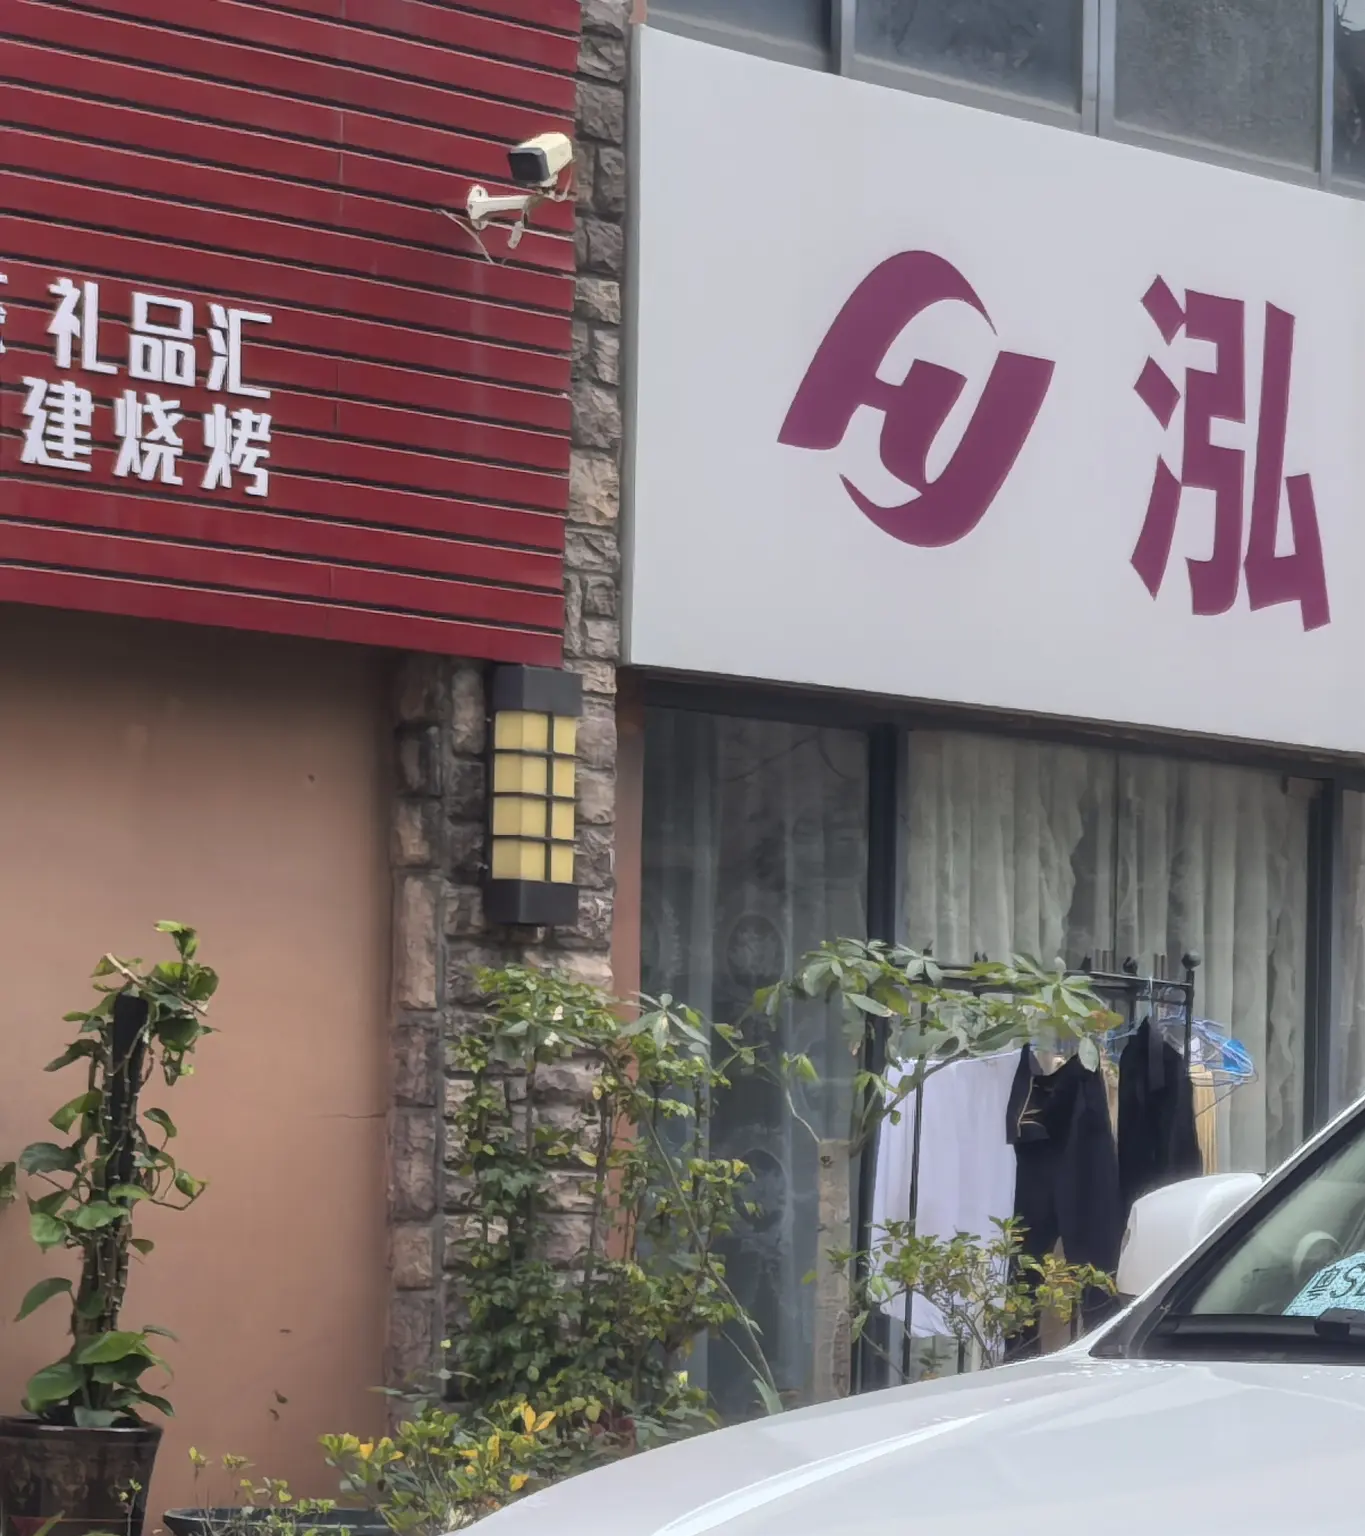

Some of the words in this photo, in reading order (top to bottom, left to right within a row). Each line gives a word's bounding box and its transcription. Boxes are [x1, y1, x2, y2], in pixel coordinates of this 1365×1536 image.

[0, 274, 273, 399] 礼品汇
[20, 375, 273, 497] 建烧烤
